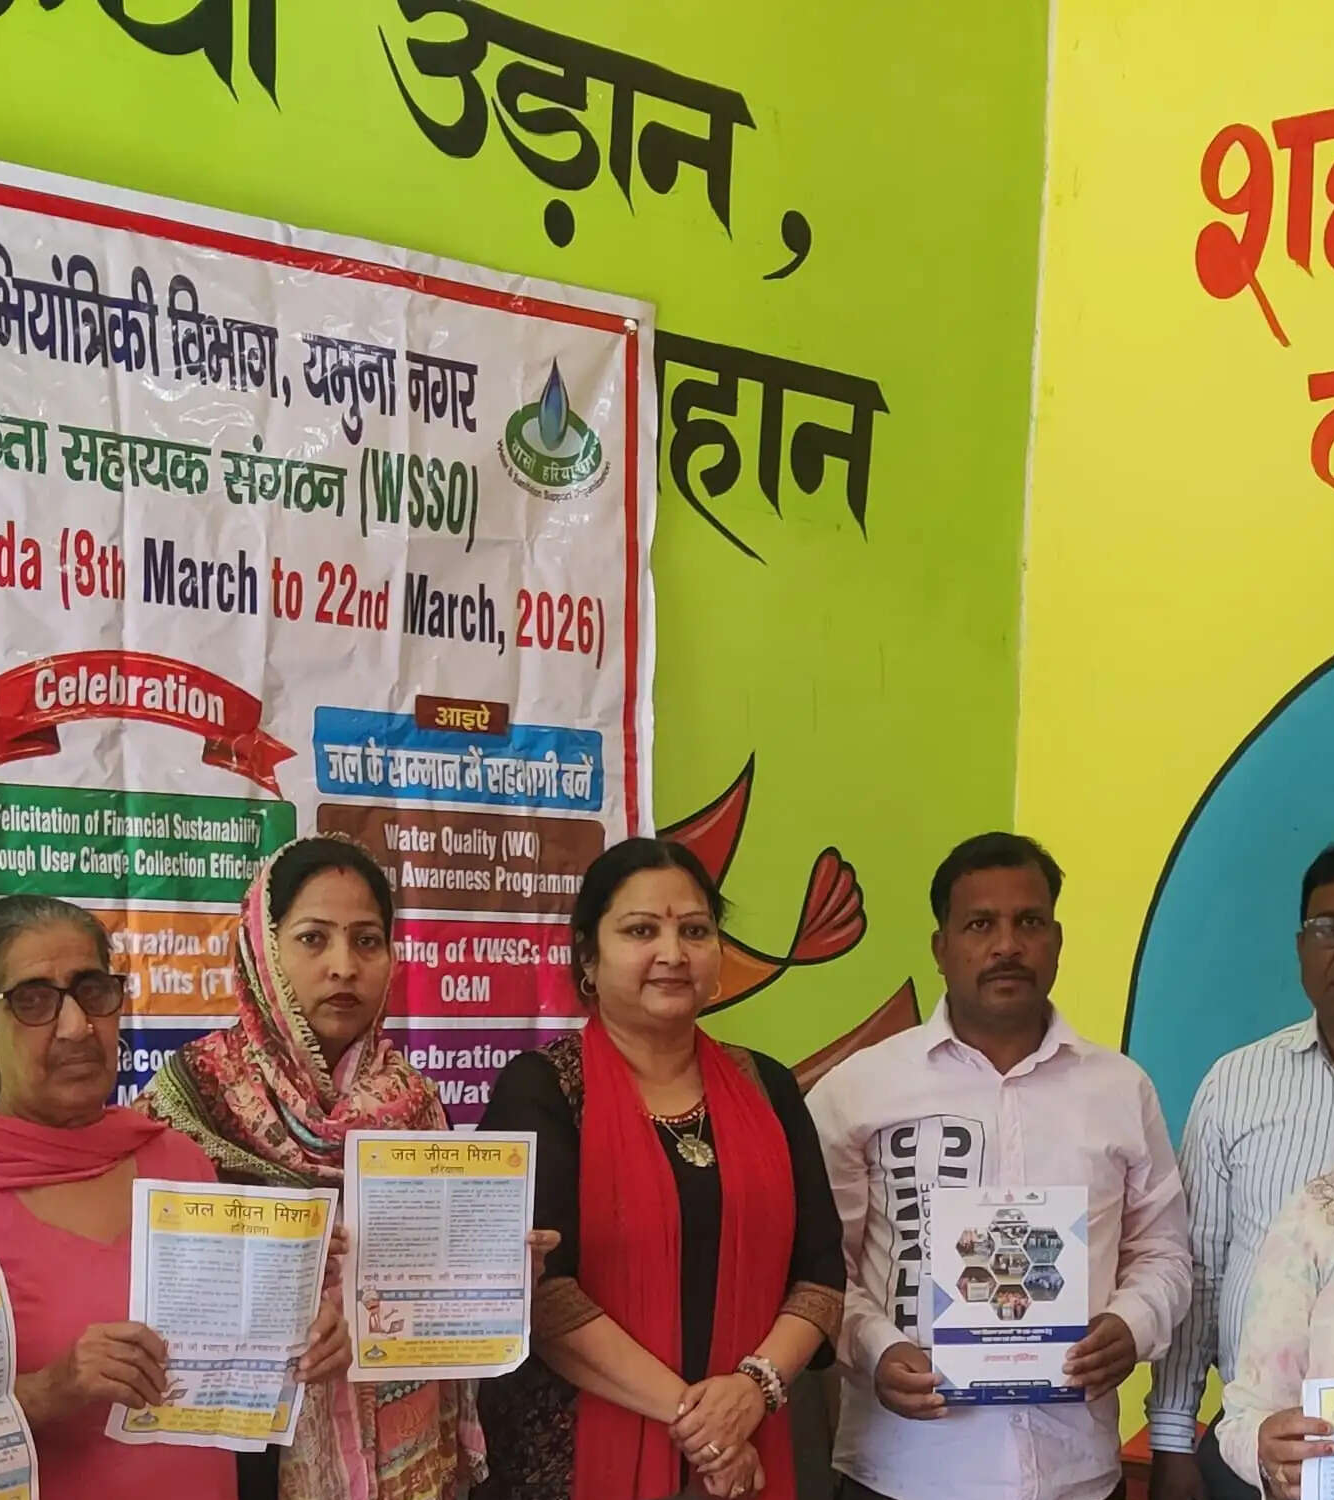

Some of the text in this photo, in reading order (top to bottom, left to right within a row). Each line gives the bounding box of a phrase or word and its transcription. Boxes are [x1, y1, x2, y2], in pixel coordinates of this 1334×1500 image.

[167, 273, 292, 408] विभाग,
[301, 330, 397, 445] यमुना
[406, 350, 478, 432] नगर
[653, 329, 891, 566] हान
[59, 424, 211, 494] सहायक
[220, 433, 348, 517] संगठन
[359, 446, 479, 553] (WSSO)
[59, 527, 127, 611] (8th
[142, 536, 259, 615] March
[272, 557, 305, 621] to
[315, 560, 390, 632] 22nd
[403, 572, 506, 656] March,
[516, 588, 606, 669] 2026)
[34, 664, 226, 727] Celebration
[323, 743, 364, 784] जल
[364, 737, 385, 786] के
[387, 748, 462, 791] सम्मान
[461, 744, 483, 792] में
[560, 754, 595, 800] बनें
[84, 809, 100, 834] of
[103, 811, 171, 839] Financial
[384, 823, 540, 864] Water Quality (WQ)
[40, 845, 76, 874] User
[80, 846, 129, 881] Charge
[134, 848, 206, 879] Collection
[401, 861, 491, 891] Awareness
[207, 931, 230, 955] of
[445, 937, 467, 962] of
[473, 937, 540, 966] VWSCs
[547, 944, 572, 964] on
[149, 965, 194, 994] Kits
[441, 975, 490, 1002] O&M
[404, 1045, 522, 1069] ebratio
[438, 1080, 491, 1104] Wat
[391, 1144, 501, 1162] जल जीवन मिशन
[183, 1202, 214, 1217] जल
[223, 1200, 264, 1221] जीवन
